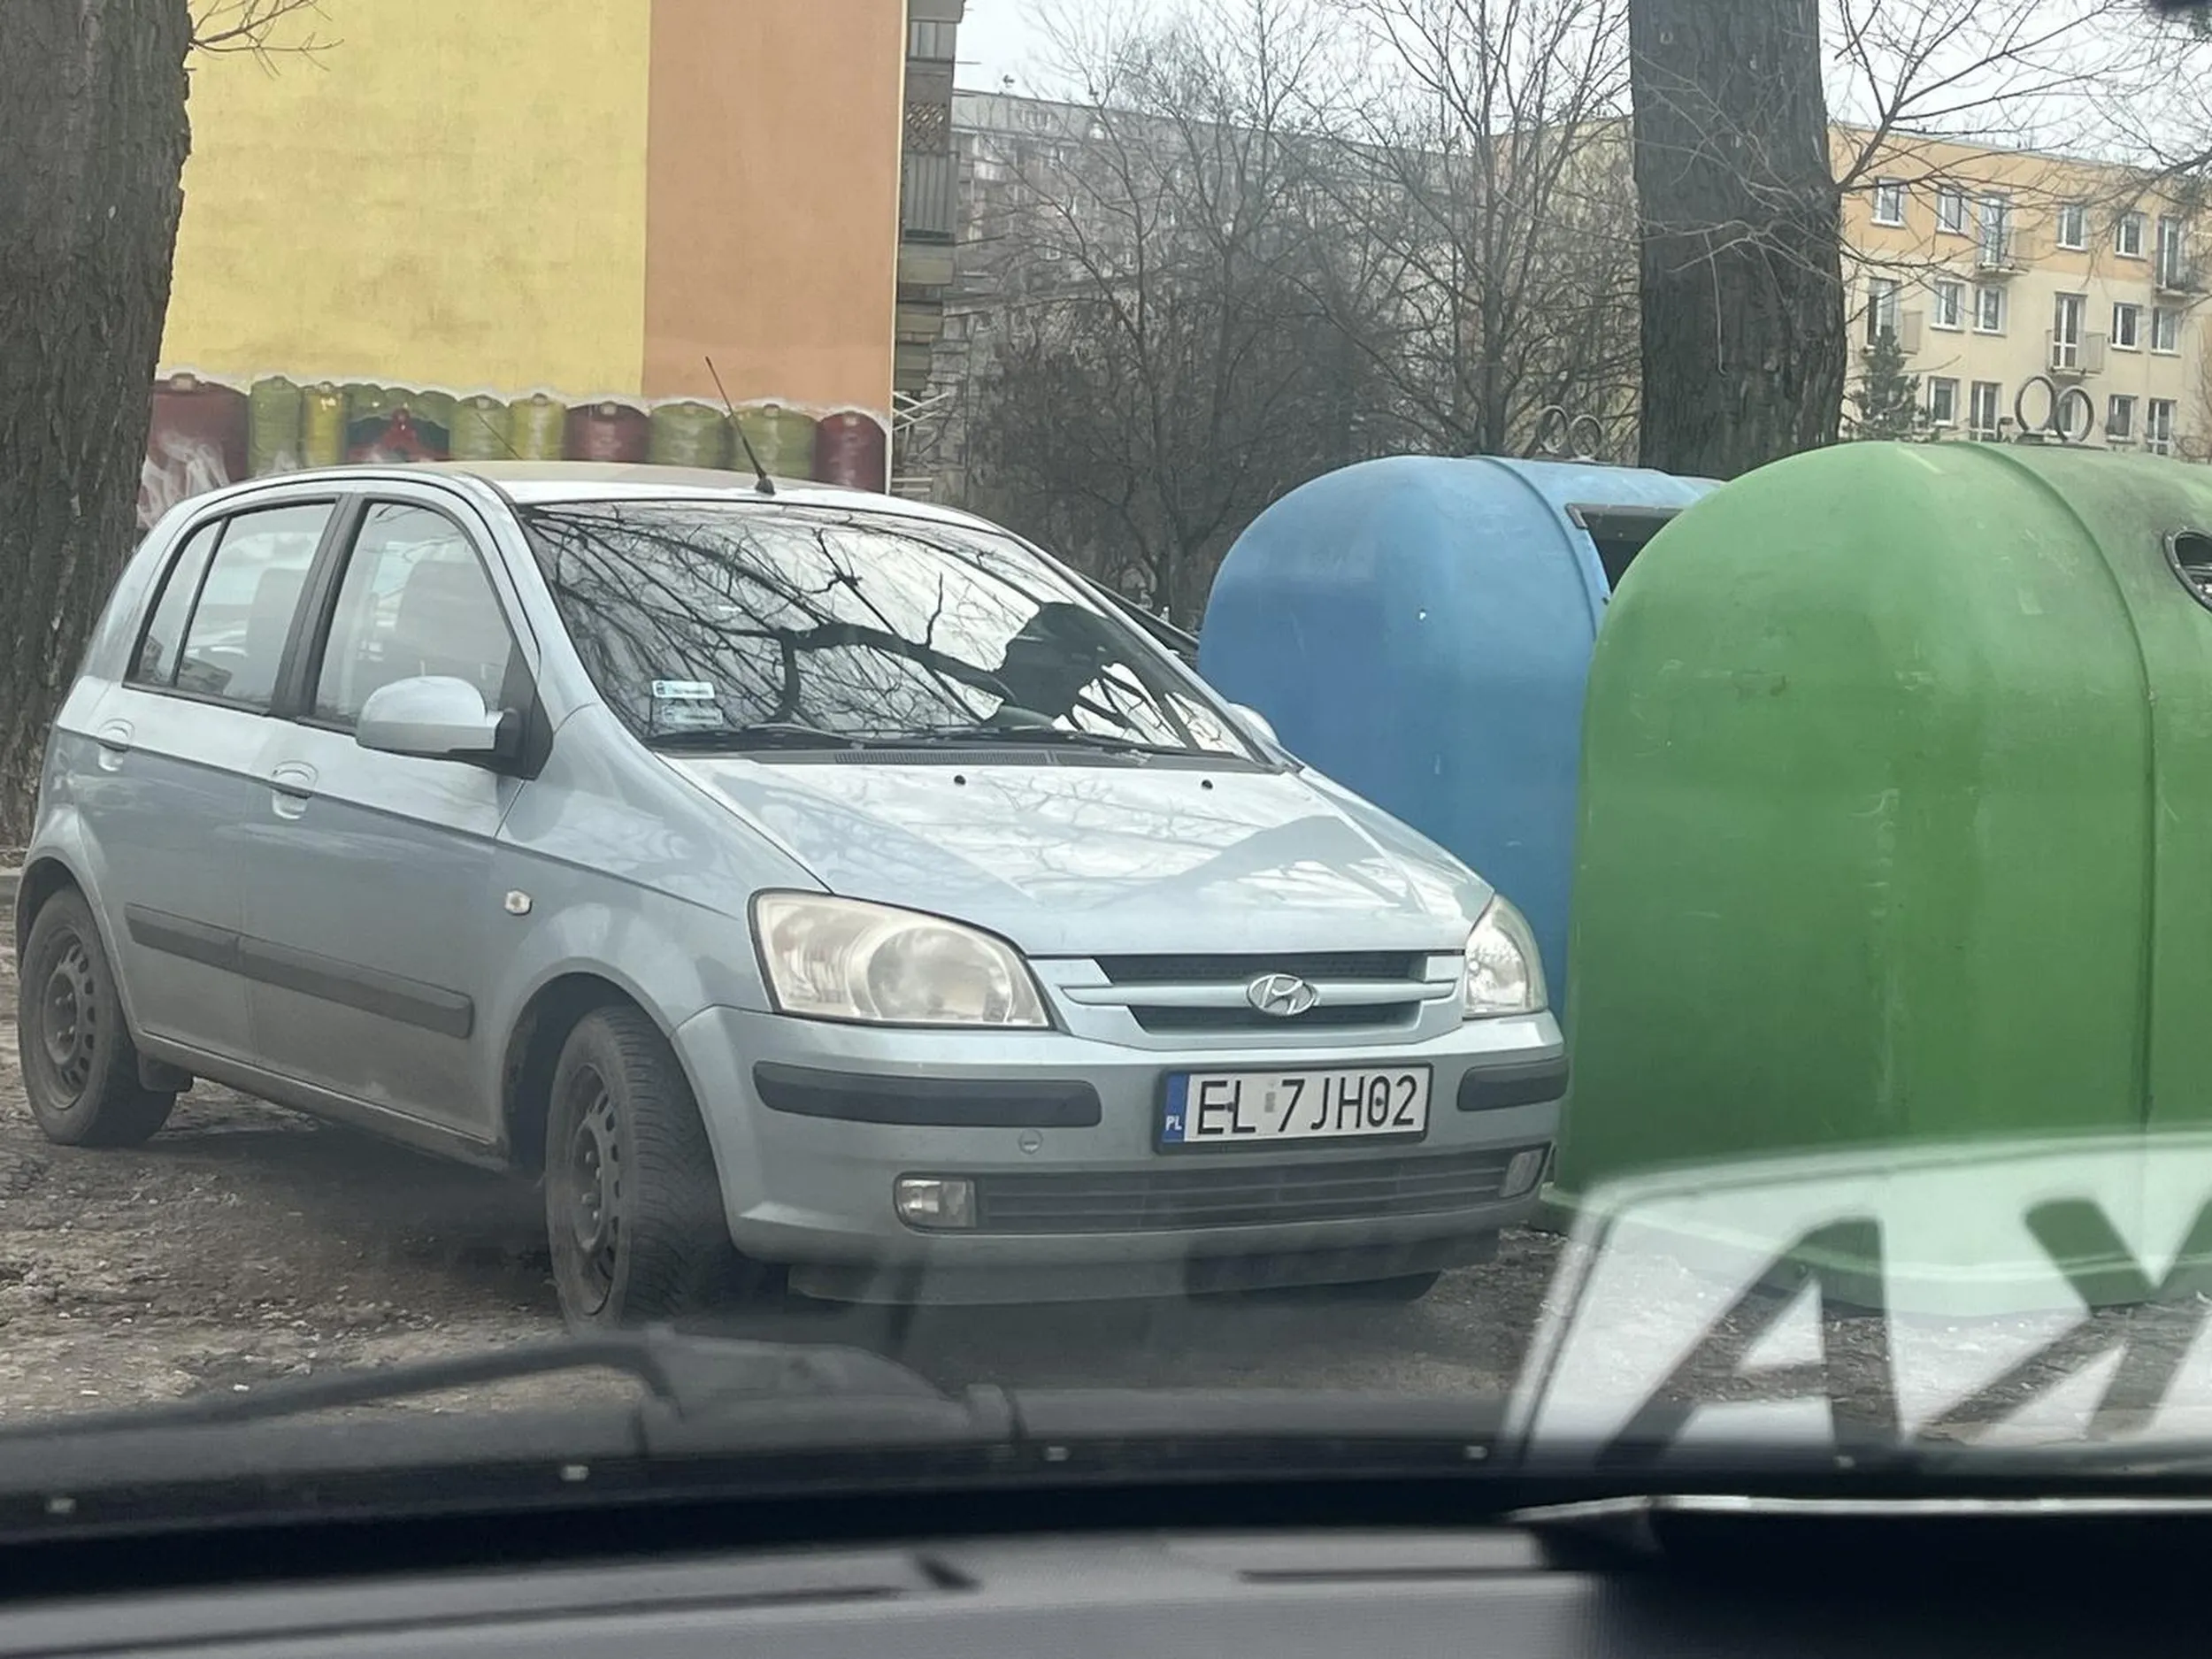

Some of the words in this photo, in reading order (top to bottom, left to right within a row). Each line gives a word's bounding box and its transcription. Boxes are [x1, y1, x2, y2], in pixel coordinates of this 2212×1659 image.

[1197, 1079, 1256, 1134] EL
[1278, 1074, 1417, 1133] 7JH02
[1164, 1115, 1183, 1132] PL
